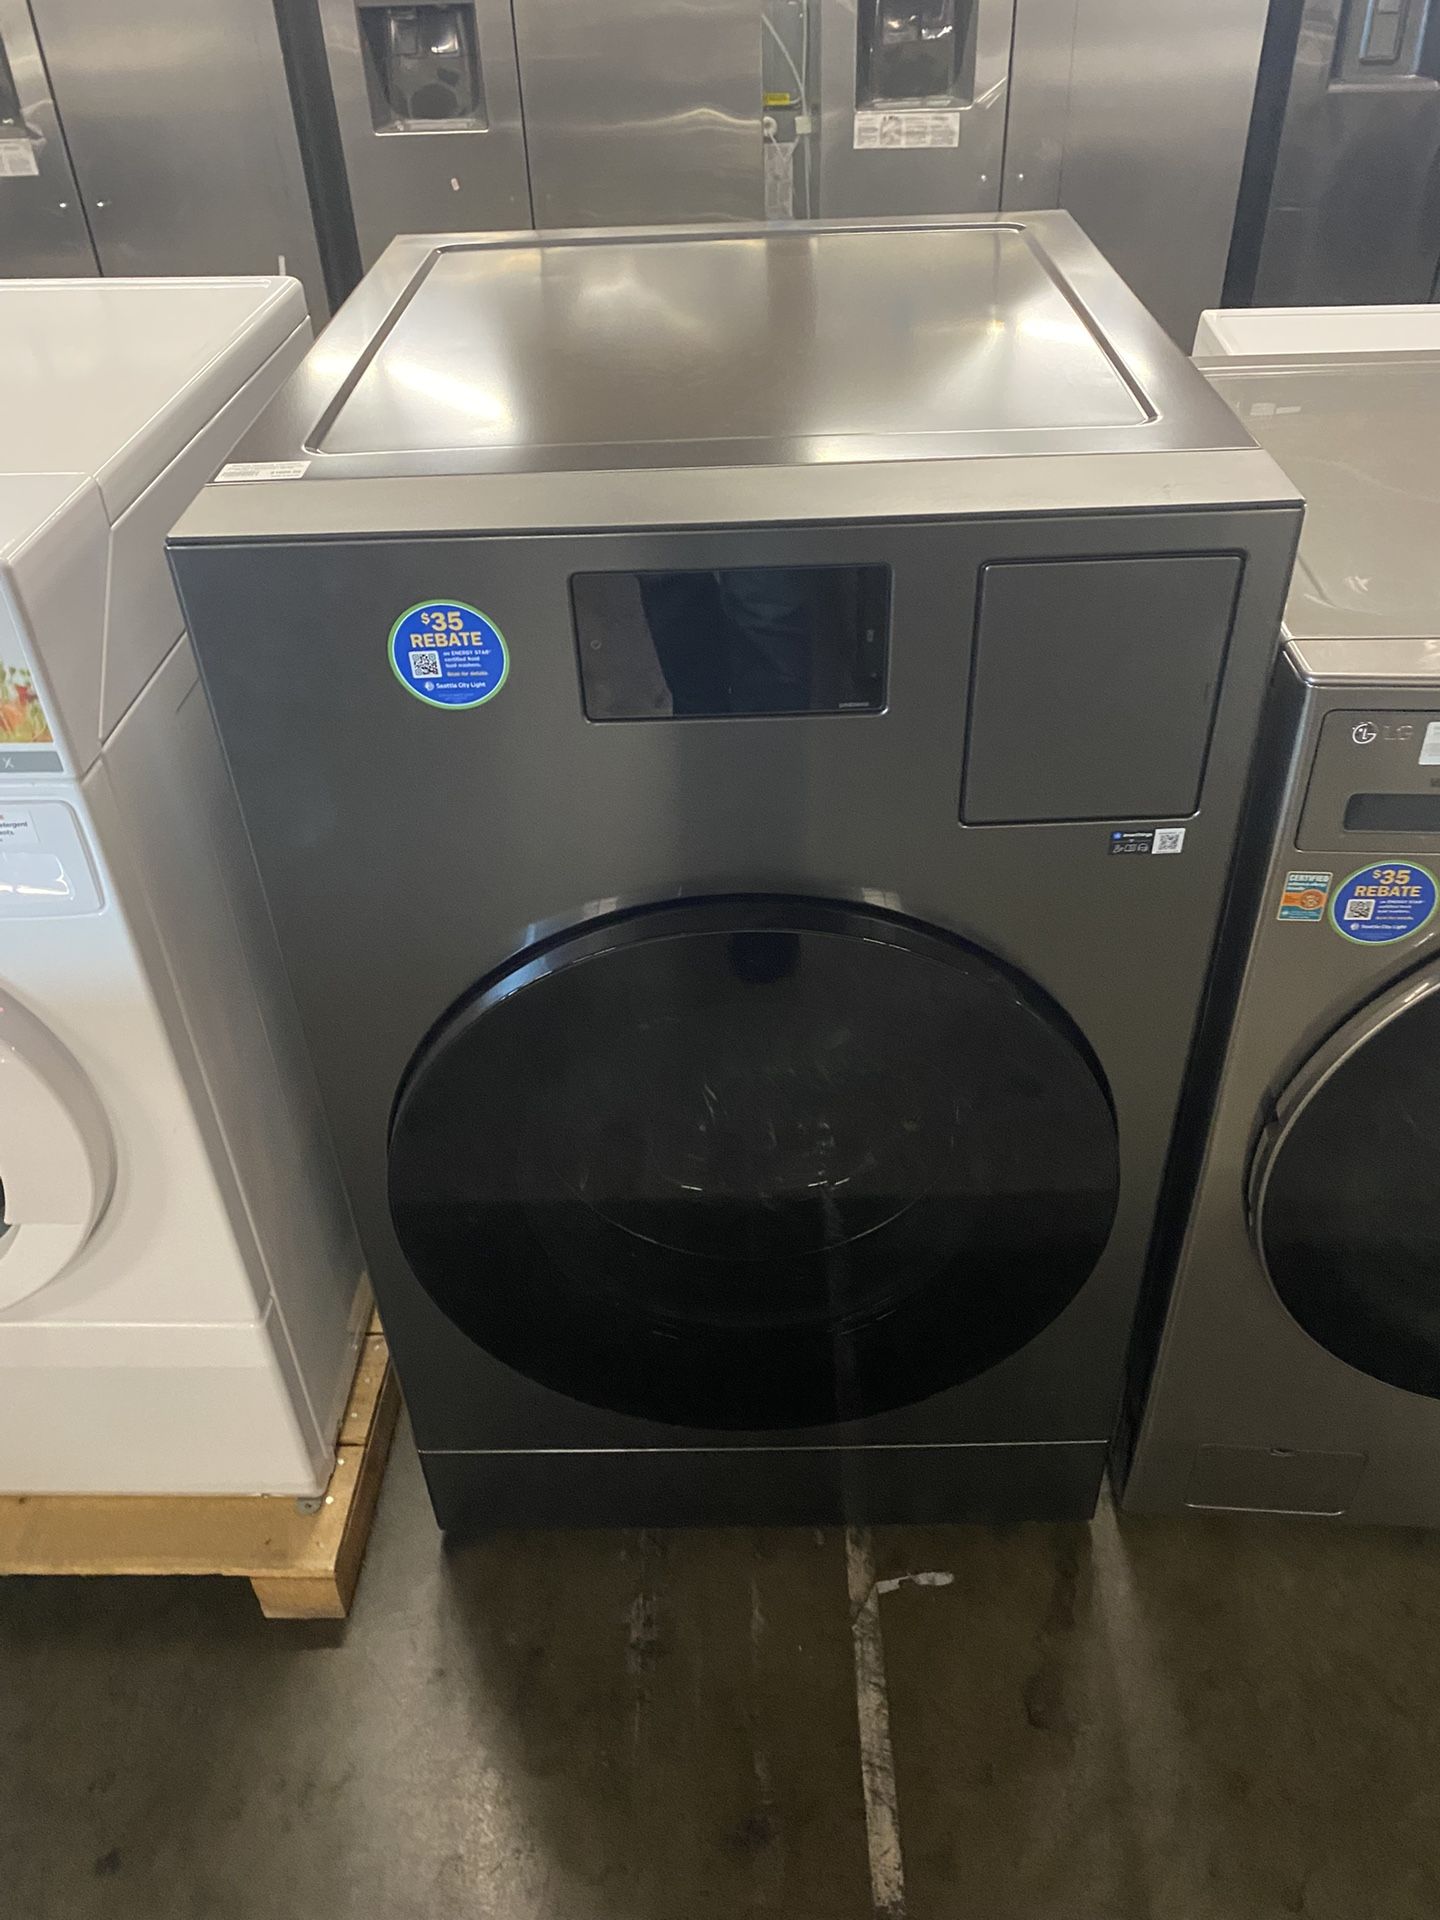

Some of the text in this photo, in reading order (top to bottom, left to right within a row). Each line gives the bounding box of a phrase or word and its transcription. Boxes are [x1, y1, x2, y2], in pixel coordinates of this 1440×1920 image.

[421, 611, 464, 631] $35
[410, 632, 483, 648] REBATE
[1289, 874, 1329, 882] CERTIFIED
[1372, 869, 1411, 885] $35
[1354, 885, 1423, 897] REBATE
